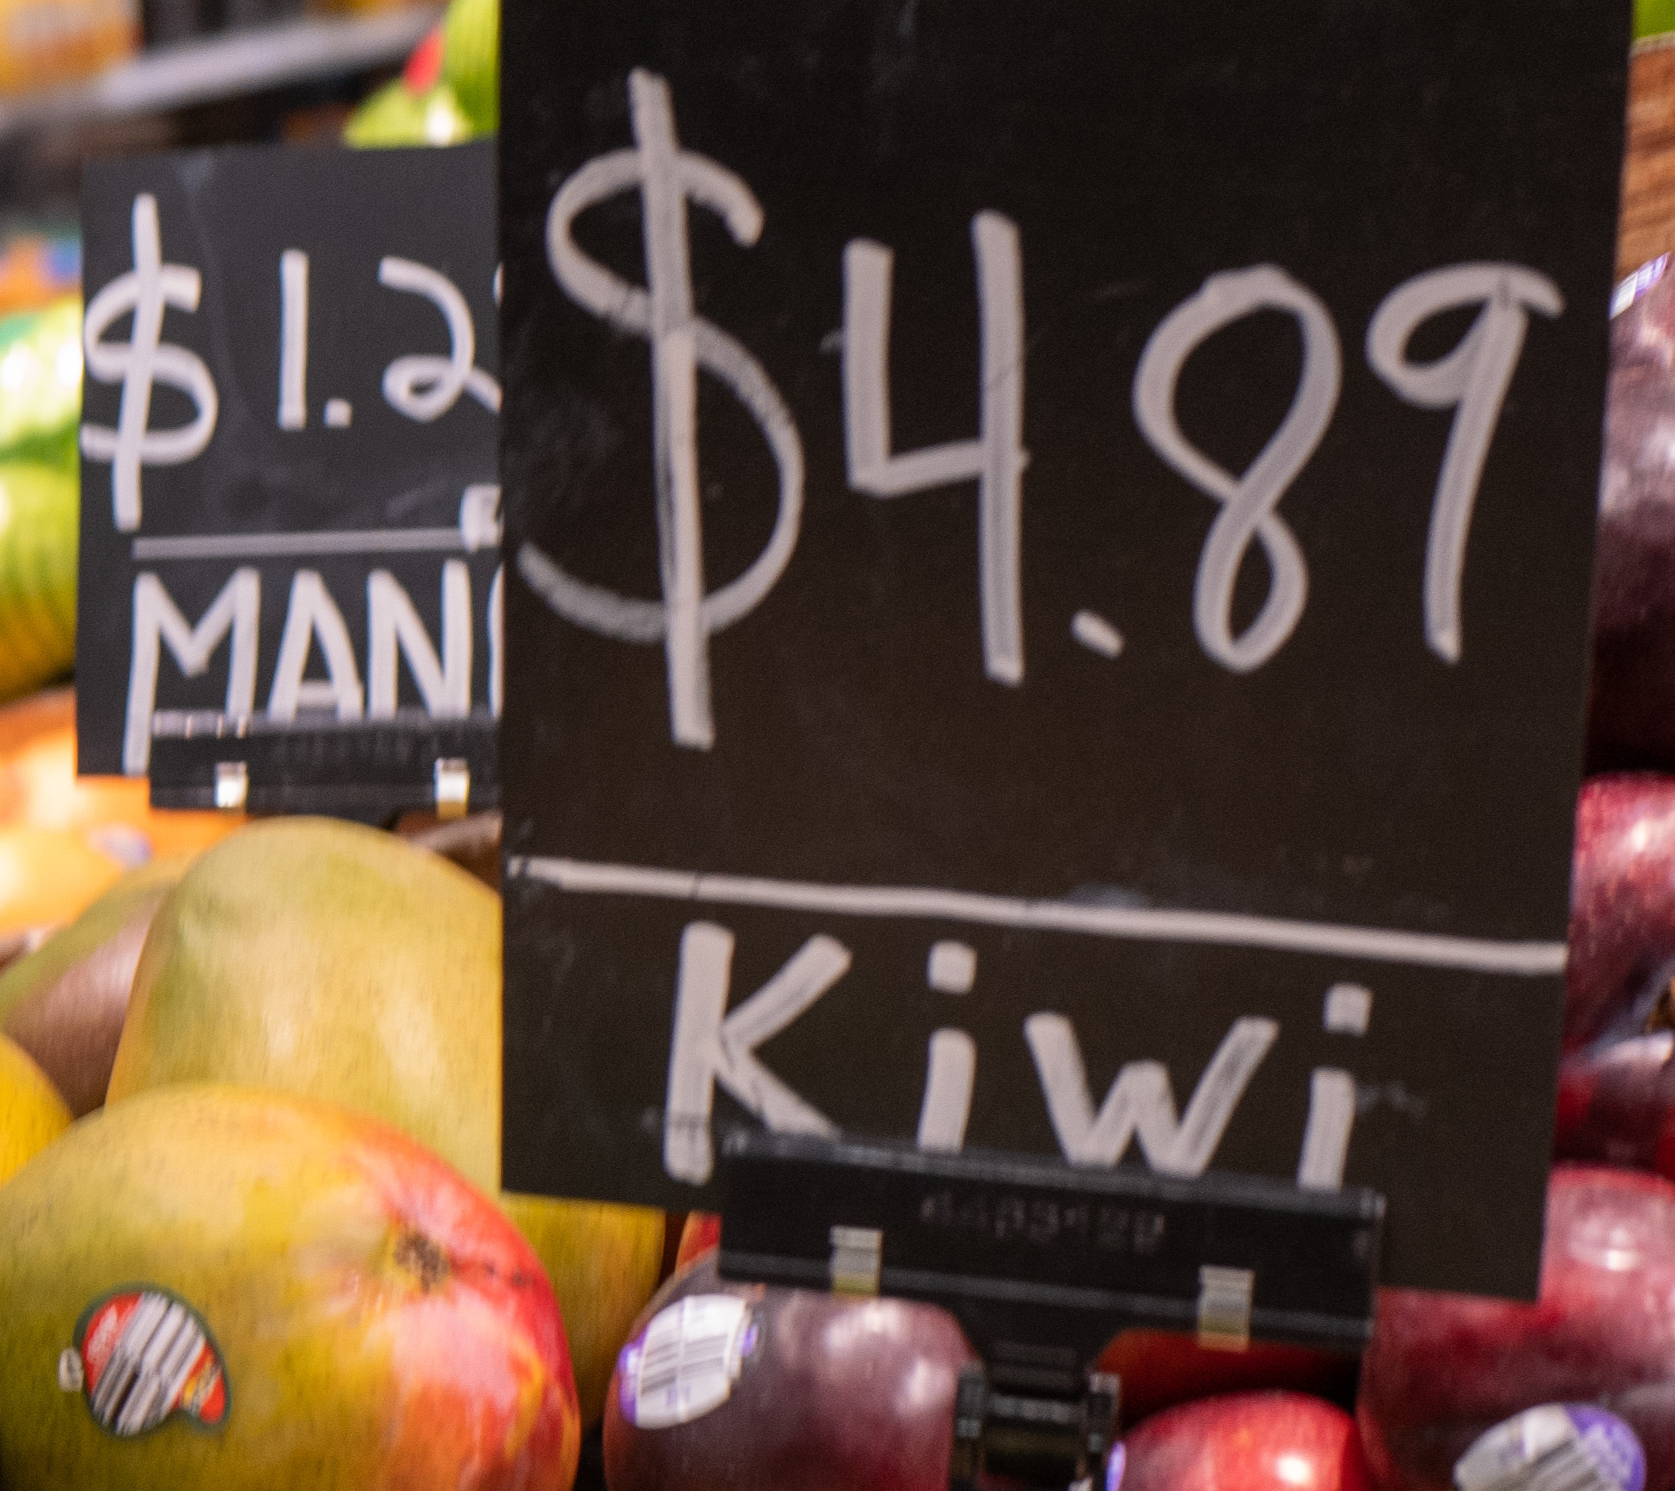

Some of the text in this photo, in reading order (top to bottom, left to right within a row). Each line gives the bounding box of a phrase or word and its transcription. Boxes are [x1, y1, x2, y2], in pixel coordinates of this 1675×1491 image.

[79, 192, 503, 532] $1.2
[517, 67, 1564, 749] $4.89
[122, 557, 503, 776] MAN
[664, 922, 1373, 1189] Kiwi
